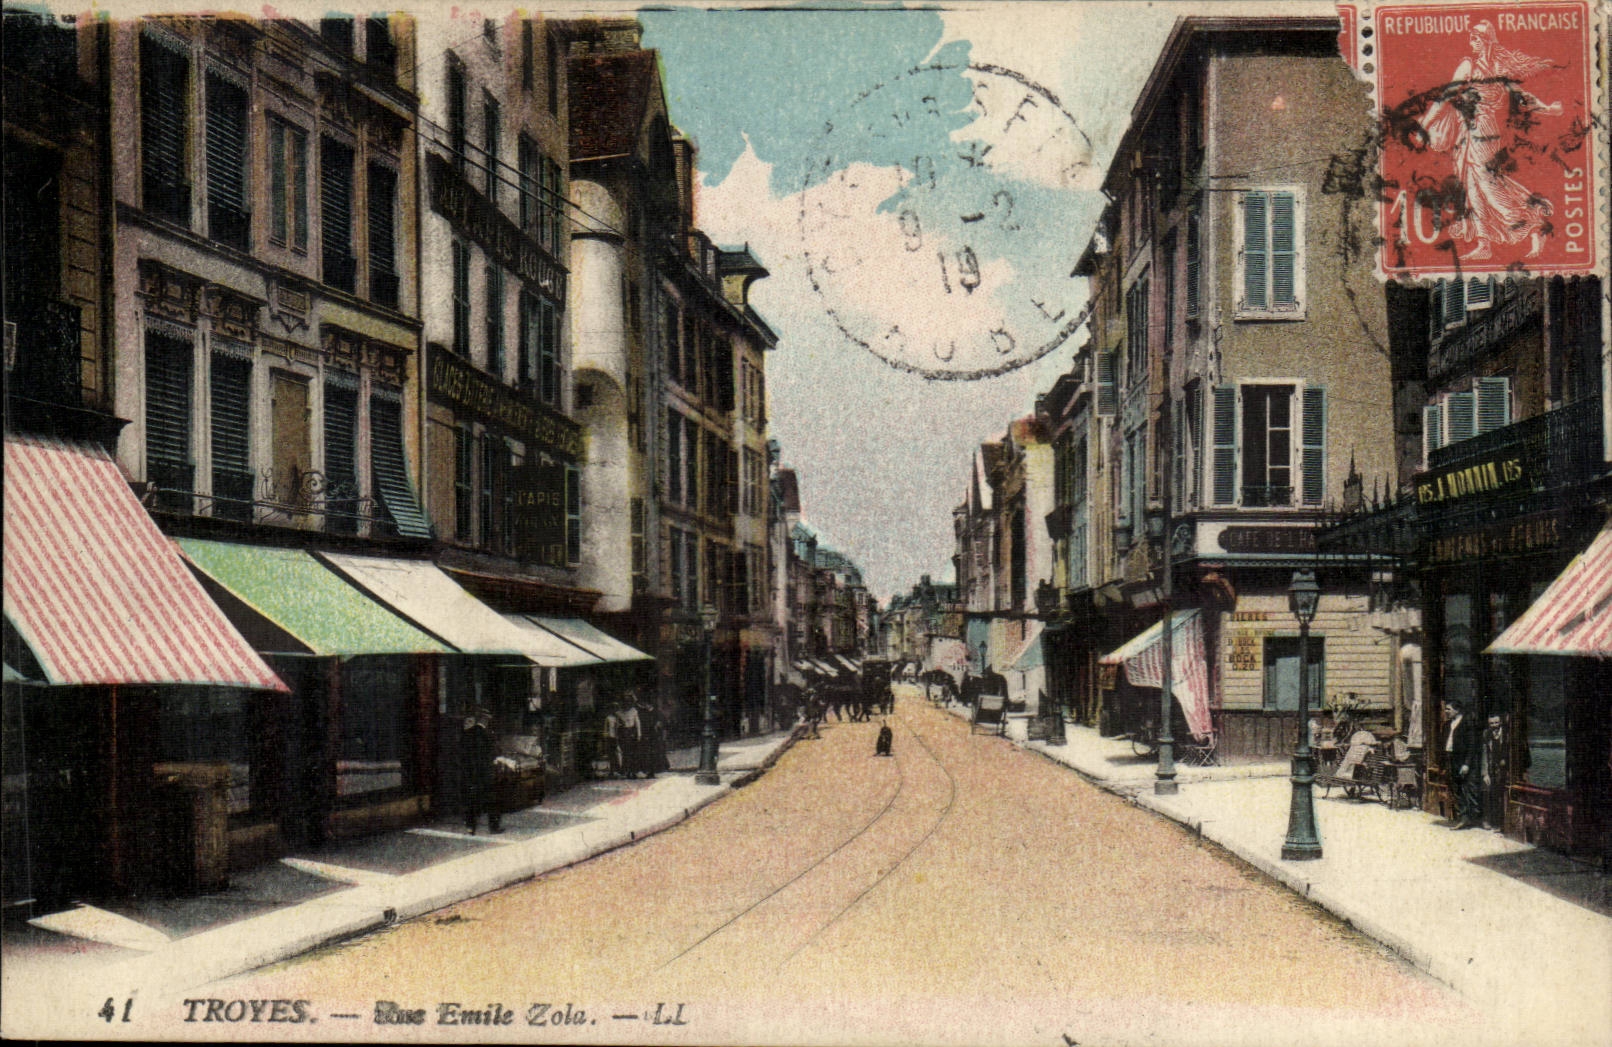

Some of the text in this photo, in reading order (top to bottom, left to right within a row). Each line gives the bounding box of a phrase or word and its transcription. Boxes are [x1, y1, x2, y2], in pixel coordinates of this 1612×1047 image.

[1497, 11, 1580, 32] FRANÇAISE
[1390, 189, 1441, 244] 10
[1564, 166, 1585, 253] POSTES
[1228, 654, 1256, 663] BOCK
